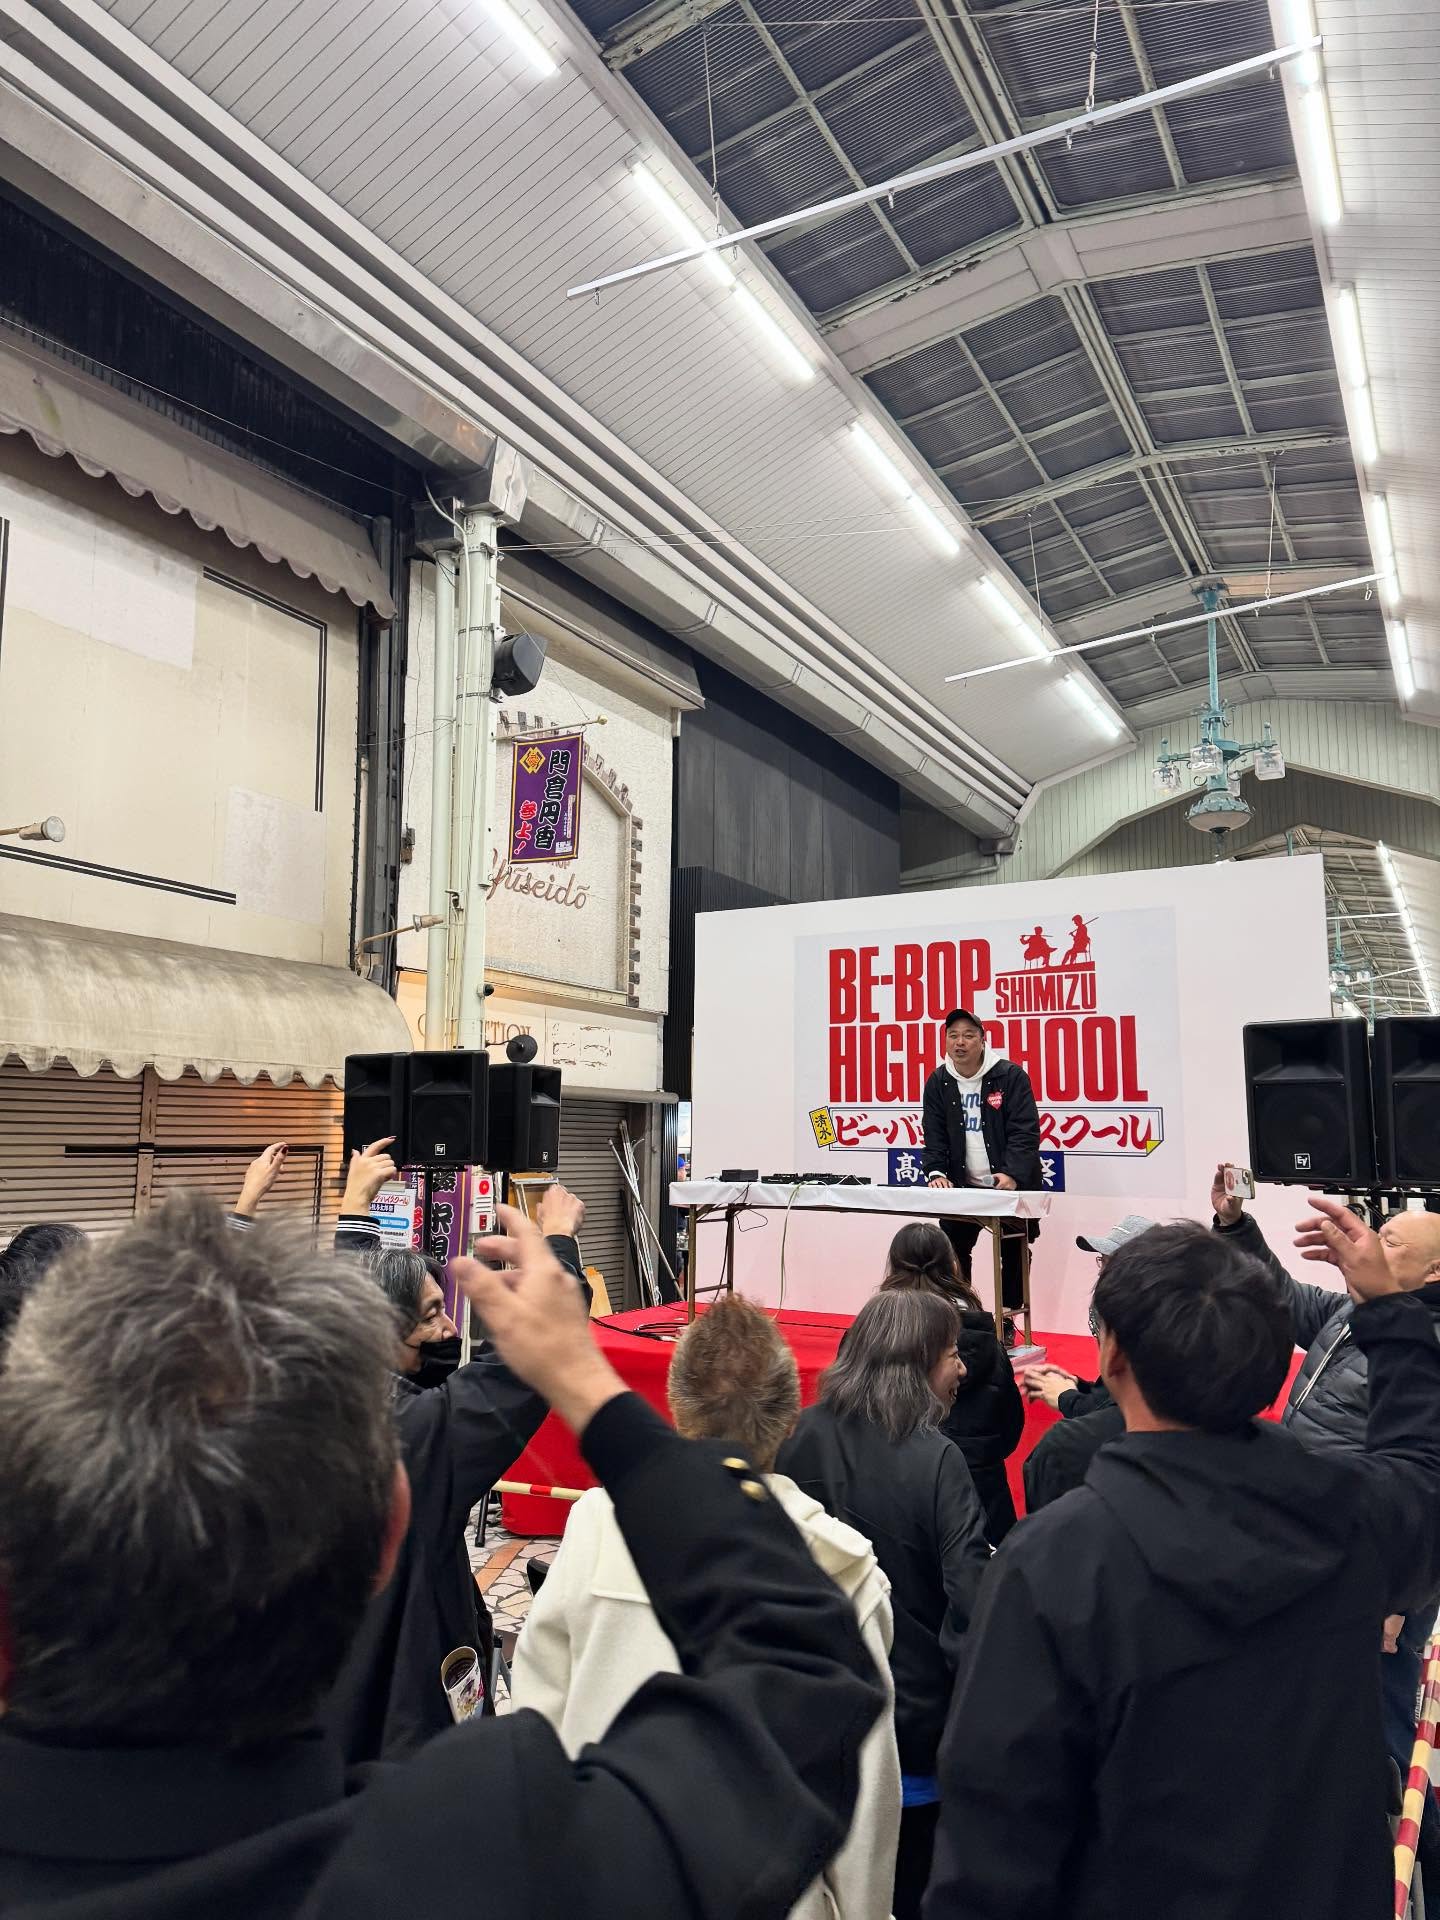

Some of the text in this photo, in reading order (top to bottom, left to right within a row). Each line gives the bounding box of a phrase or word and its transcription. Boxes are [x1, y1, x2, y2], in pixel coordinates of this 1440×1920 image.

[829, 939, 992, 1024] BE-BOP
[995, 973, 1097, 1013] SHIMIZU
[814, 1113, 832, 1140] 清水
